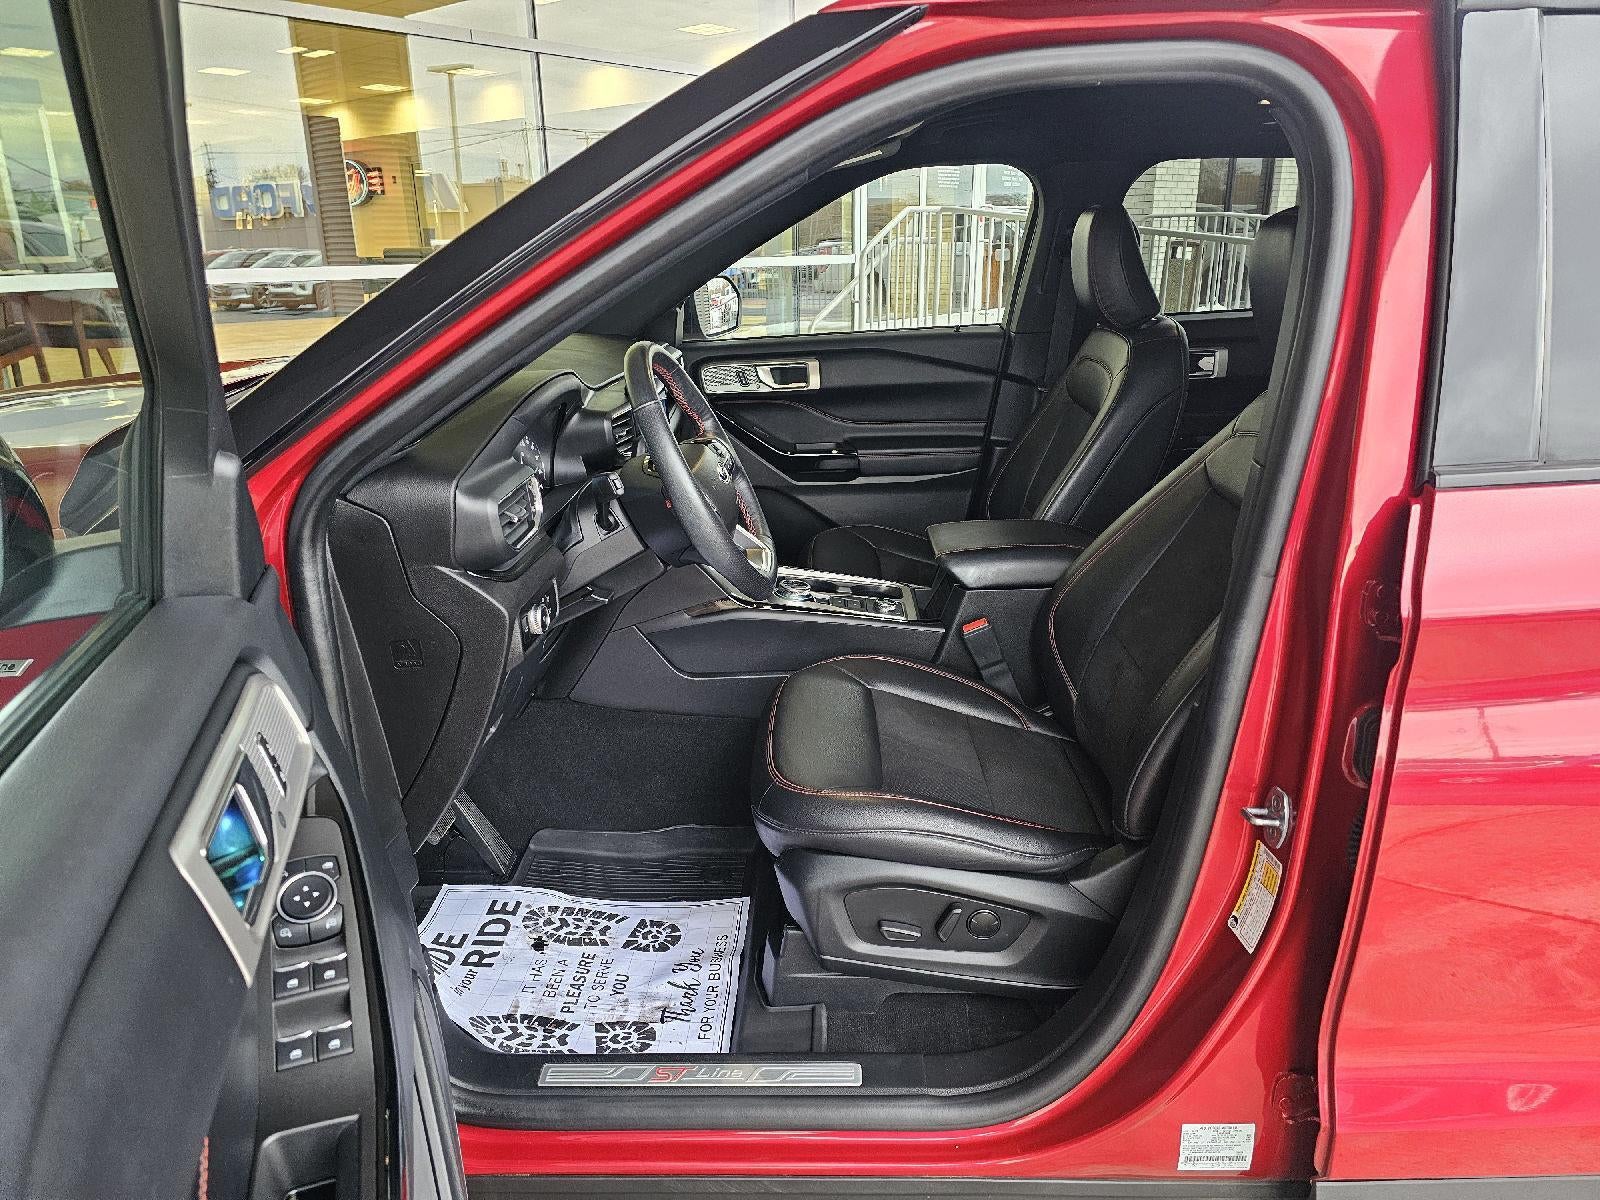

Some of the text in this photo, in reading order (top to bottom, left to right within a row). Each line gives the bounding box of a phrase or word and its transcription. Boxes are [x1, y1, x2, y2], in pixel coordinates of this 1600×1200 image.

[460, 899, 522, 967] RIDE
[461, 968, 478, 992] your
[521, 959, 548, 994] IT HAS
[543, 959, 569, 998] BEEN A
[559, 951, 597, 1014] PLEASURE
[584, 958, 615, 1010] TO SERVE
[609, 973, 630, 997] YOU
[659, 947, 705, 1024] Thank You
[704, 983, 720, 1013] YOUR
[697, 1015, 714, 1040] FOR
[647, 1067, 743, 1082] ST Line
